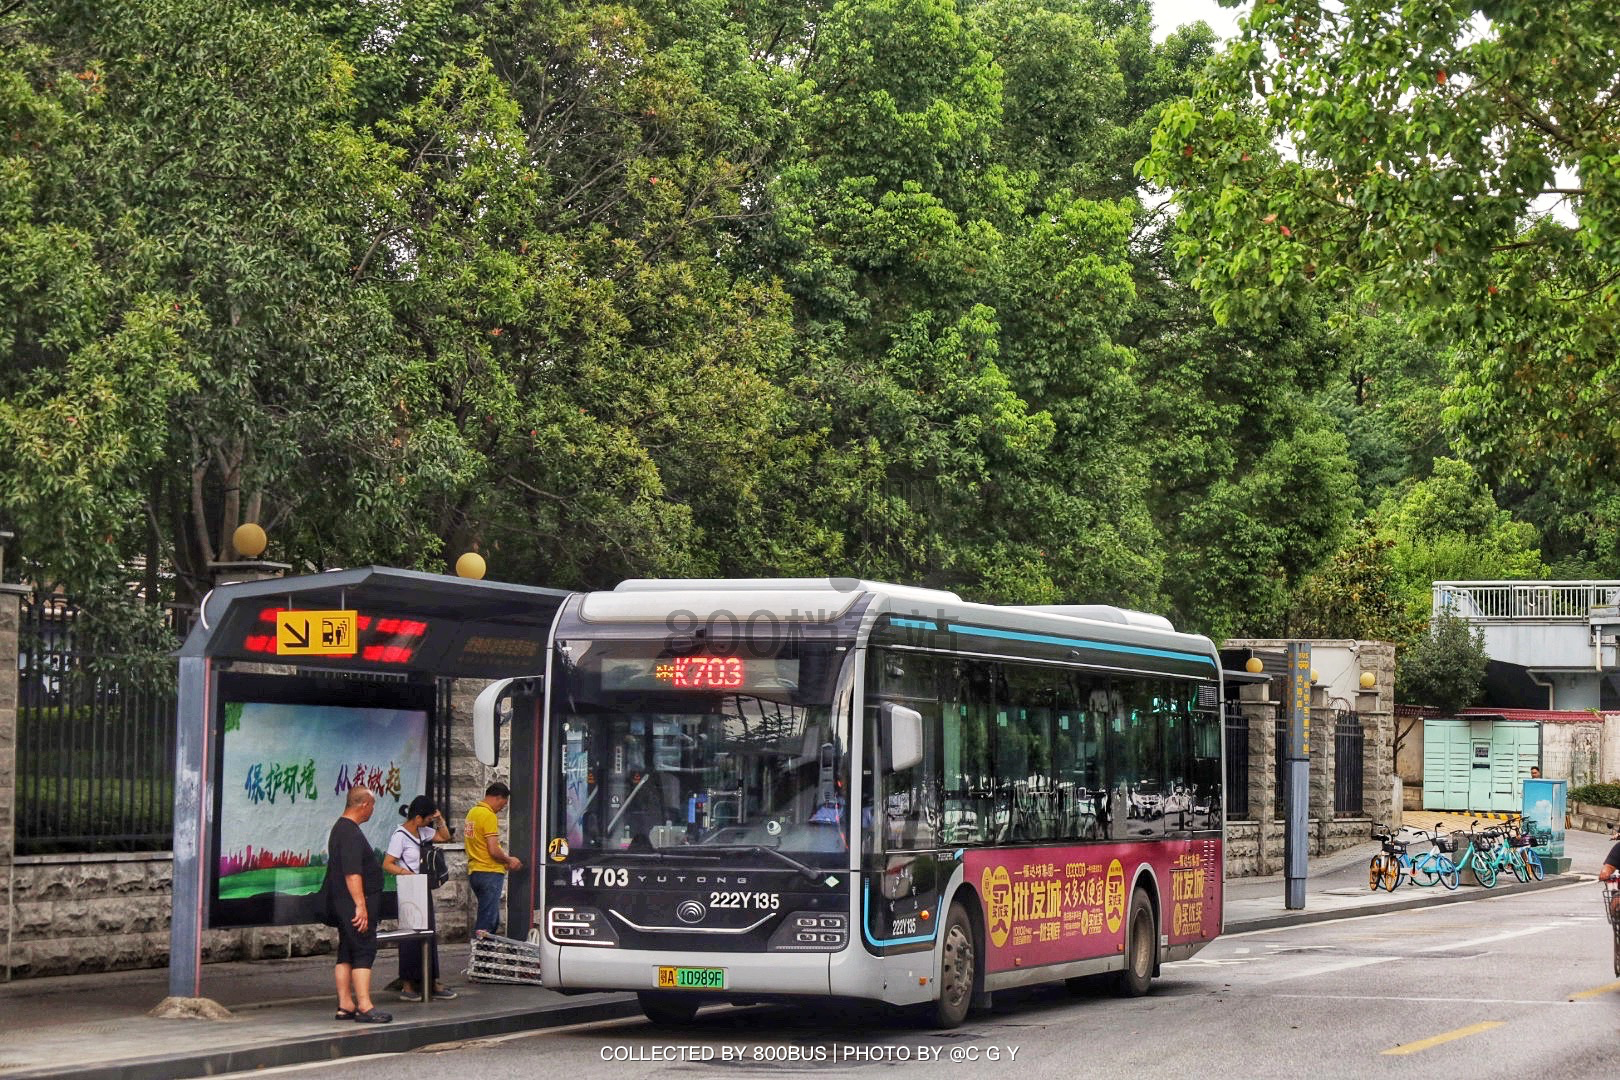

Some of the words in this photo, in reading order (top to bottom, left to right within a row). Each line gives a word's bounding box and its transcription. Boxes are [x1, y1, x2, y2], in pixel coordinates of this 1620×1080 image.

[674, 657, 743, 687] K703
[245, 759, 318, 804] 保护环境
[335, 761, 401, 801] 从我做起
[592, 868, 629, 886] 703
[637, 875, 747, 883] YUTONG
[1063, 876, 1104, 908] 又多又便宜
[1173, 868, 1205, 901] 批发城
[709, 891, 780, 909] 222Y135
[1013, 880, 1062, 921] 批发城
[892, 918, 917, 935] 222Y135
